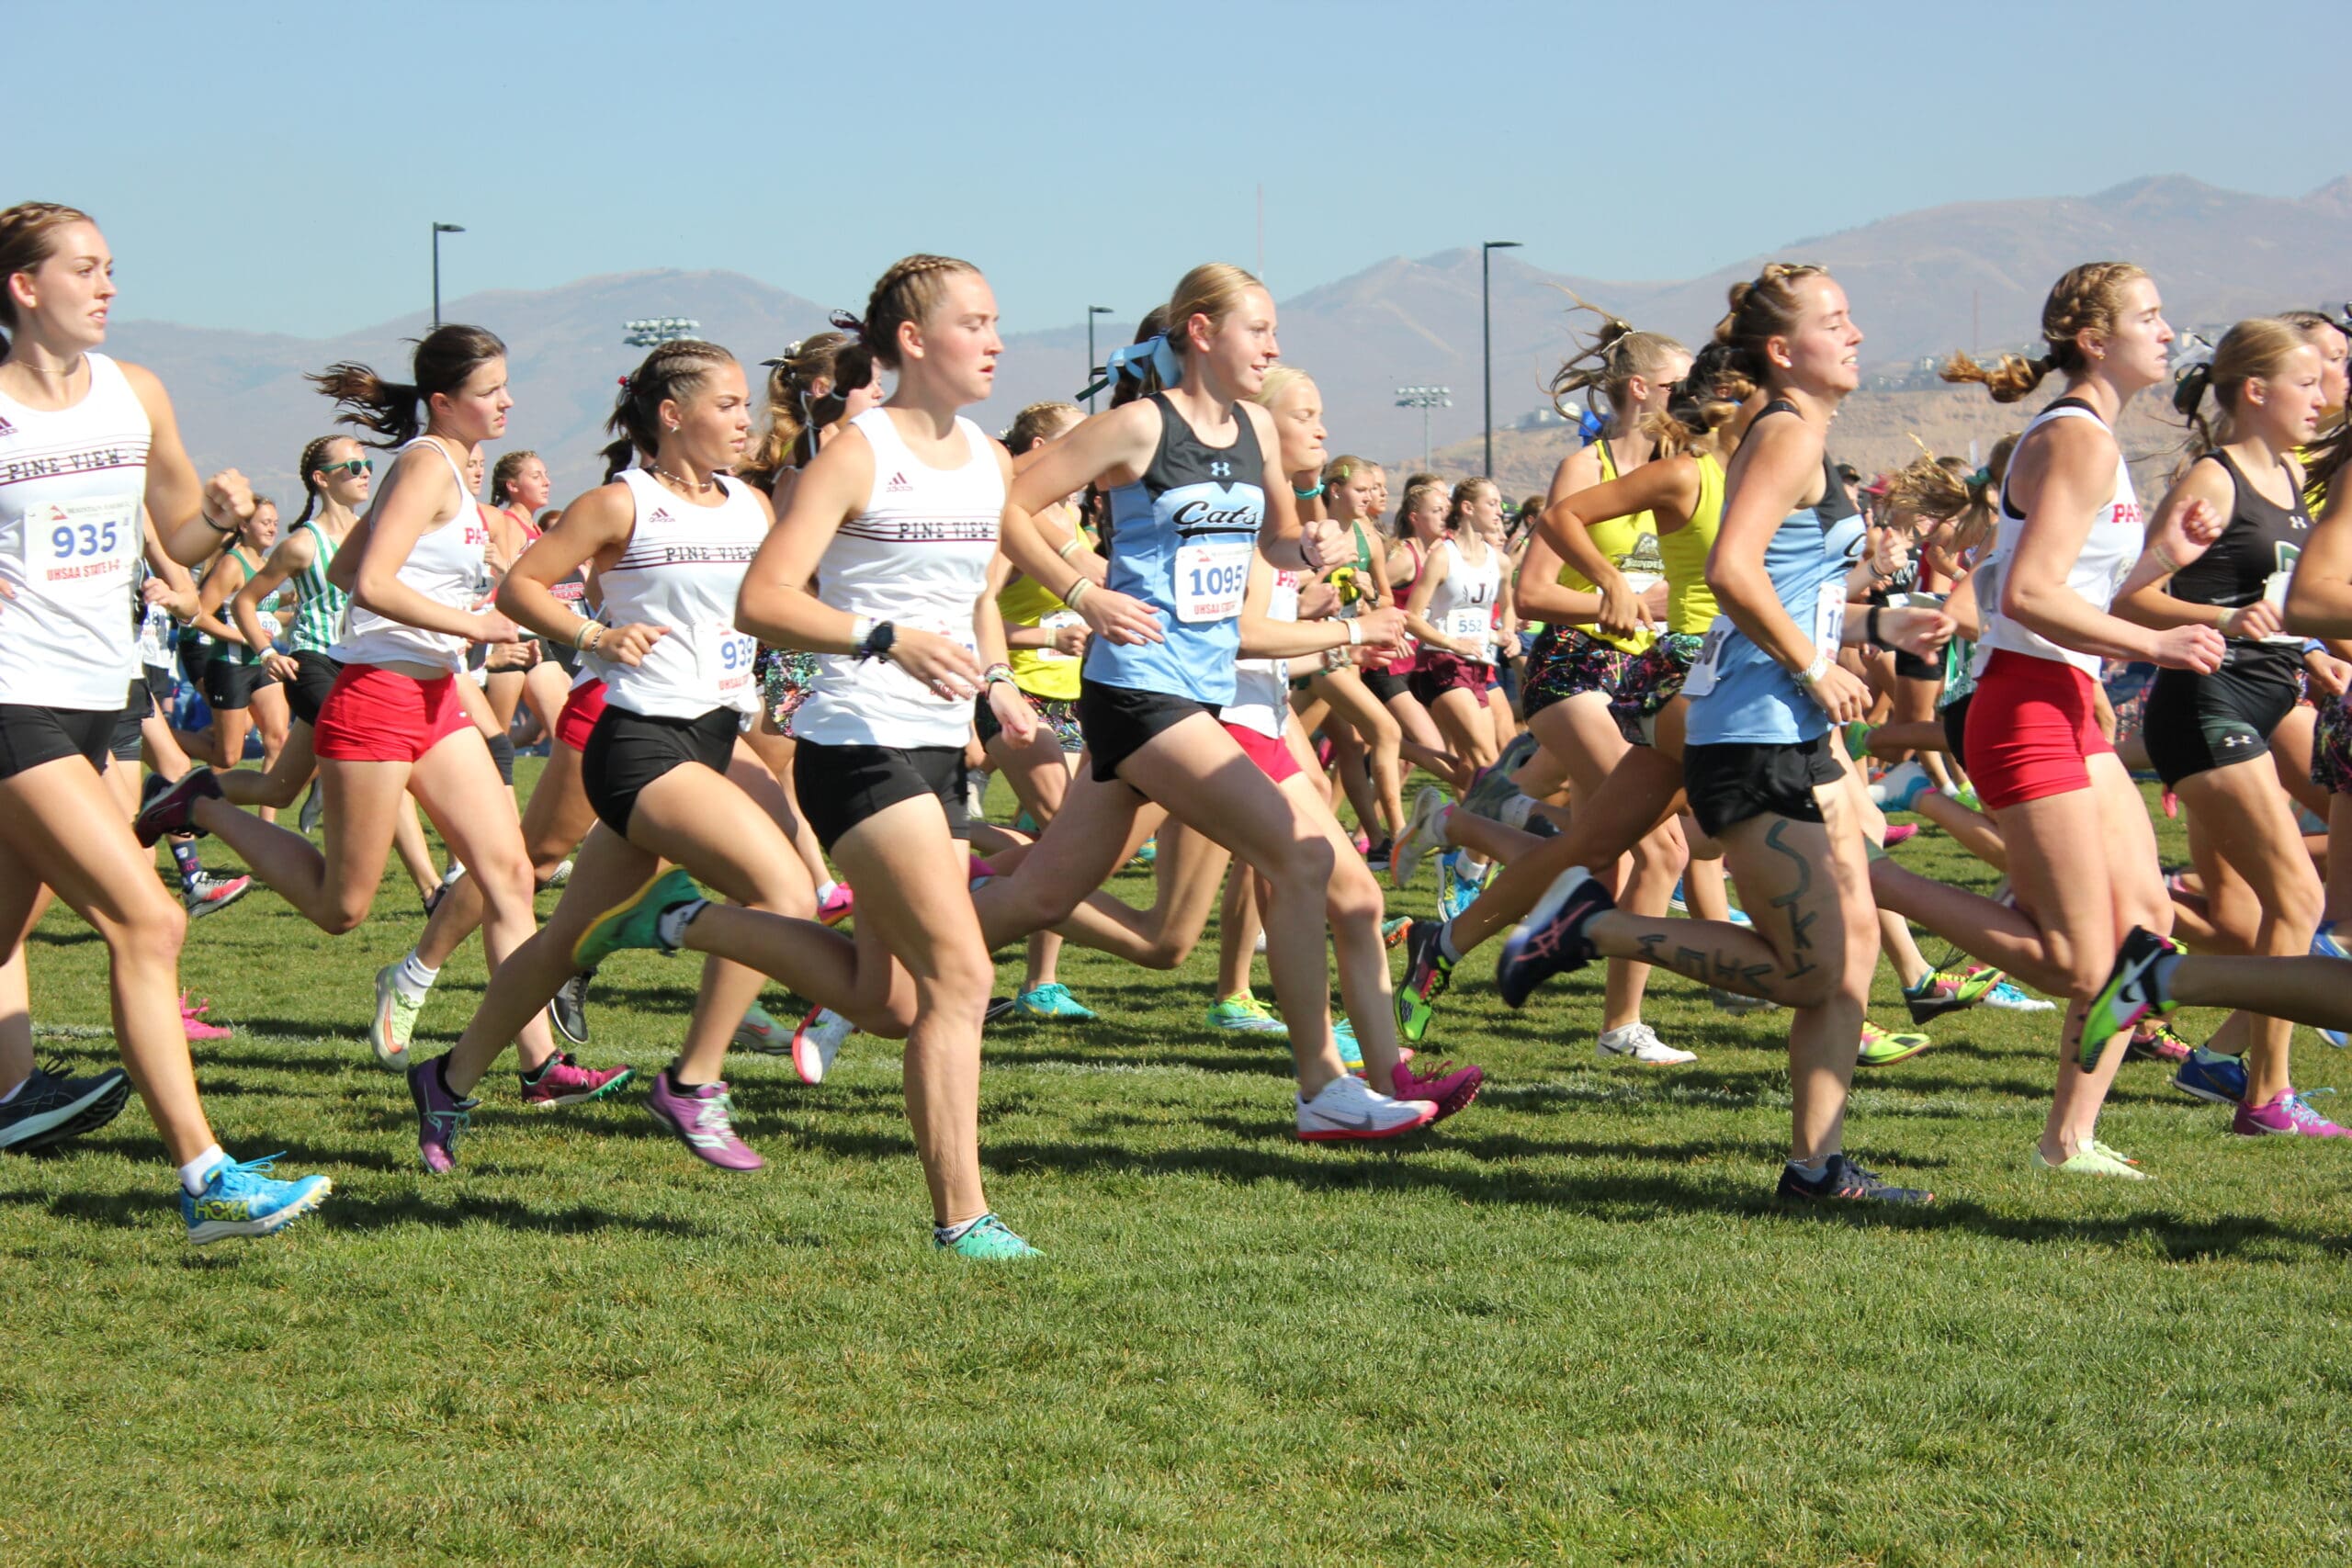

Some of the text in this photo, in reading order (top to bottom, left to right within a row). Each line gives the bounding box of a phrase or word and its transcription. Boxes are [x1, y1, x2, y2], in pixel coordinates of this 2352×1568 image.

[7, 447, 120, 479] PINE VIEW
[1172, 501, 1260, 525] Cats
[51, 521, 117, 558] 935
[899, 521, 989, 539] PINE VIEW
[664, 546, 760, 562] PINE VIEW
[47, 567, 82, 581] UHSAA
[1189, 564, 1244, 597] 1095
[1471, 582, 1487, 604] J
[1458, 619, 1483, 633] 552
[193, 1199, 251, 1221] HOKA
